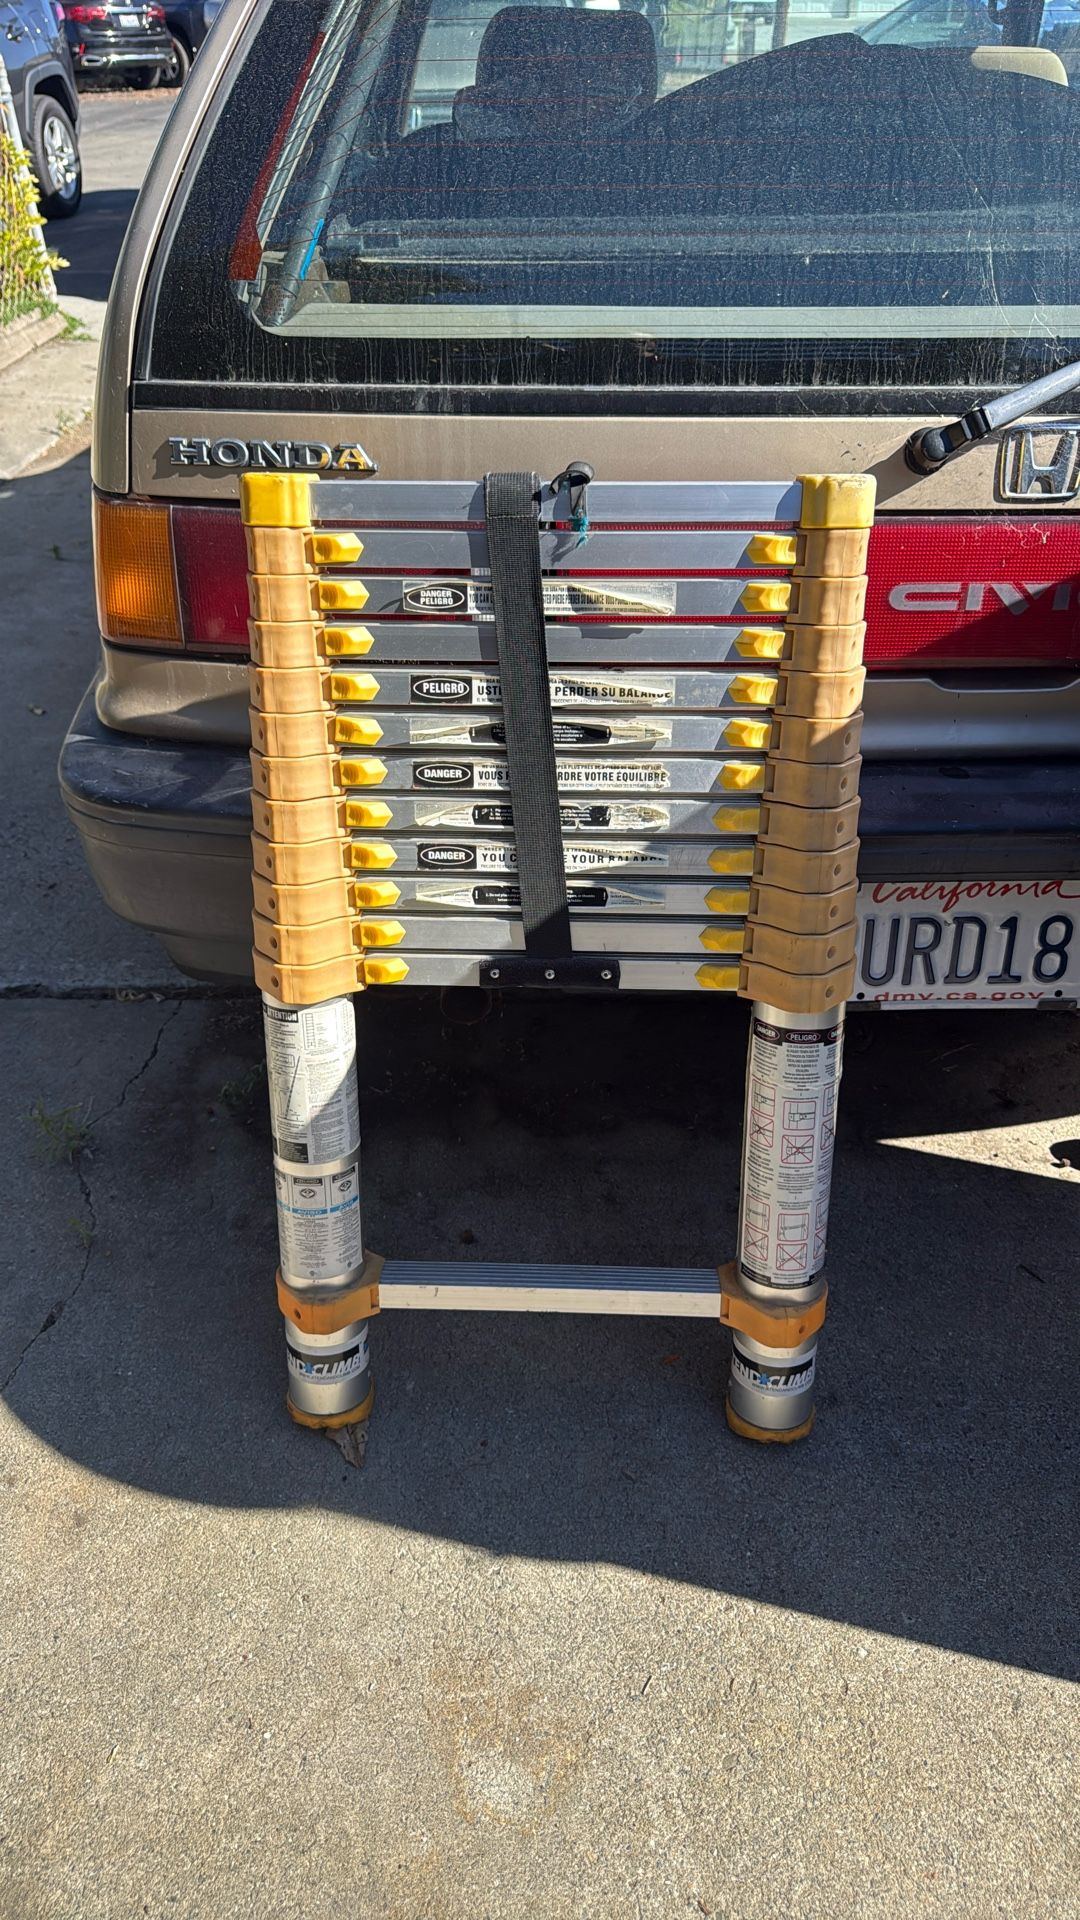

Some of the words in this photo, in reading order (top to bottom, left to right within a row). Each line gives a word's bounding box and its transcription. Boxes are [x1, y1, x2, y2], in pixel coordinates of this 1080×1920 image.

[168, 436, 378, 472] HONDA
[888, 581, 1080, 615] CIVI
[423, 682, 464, 694] PELIGRO
[554, 686, 598, 697] PERDER
[601, 687, 616, 697] SU
[424, 769, 462, 779] DANGER
[478, 770, 504, 781] VOUS
[584, 771, 614, 781] VOTRE
[616, 769, 666, 782] ÉQUILIBRE
[428, 851, 465, 861] DANGER
[482, 852, 506, 863] YOU
[572, 854, 605, 864] YOUR
[873, 879, 1080, 913] California
[861, 914, 1074, 987] URD18
[874, 990, 1045, 1001] dmv.ca.gov
[790, 1033, 818, 1042] PELIGRO
[312, 1354, 361, 1376] CLIMB
[766, 1366, 815, 1389] CLIMB
